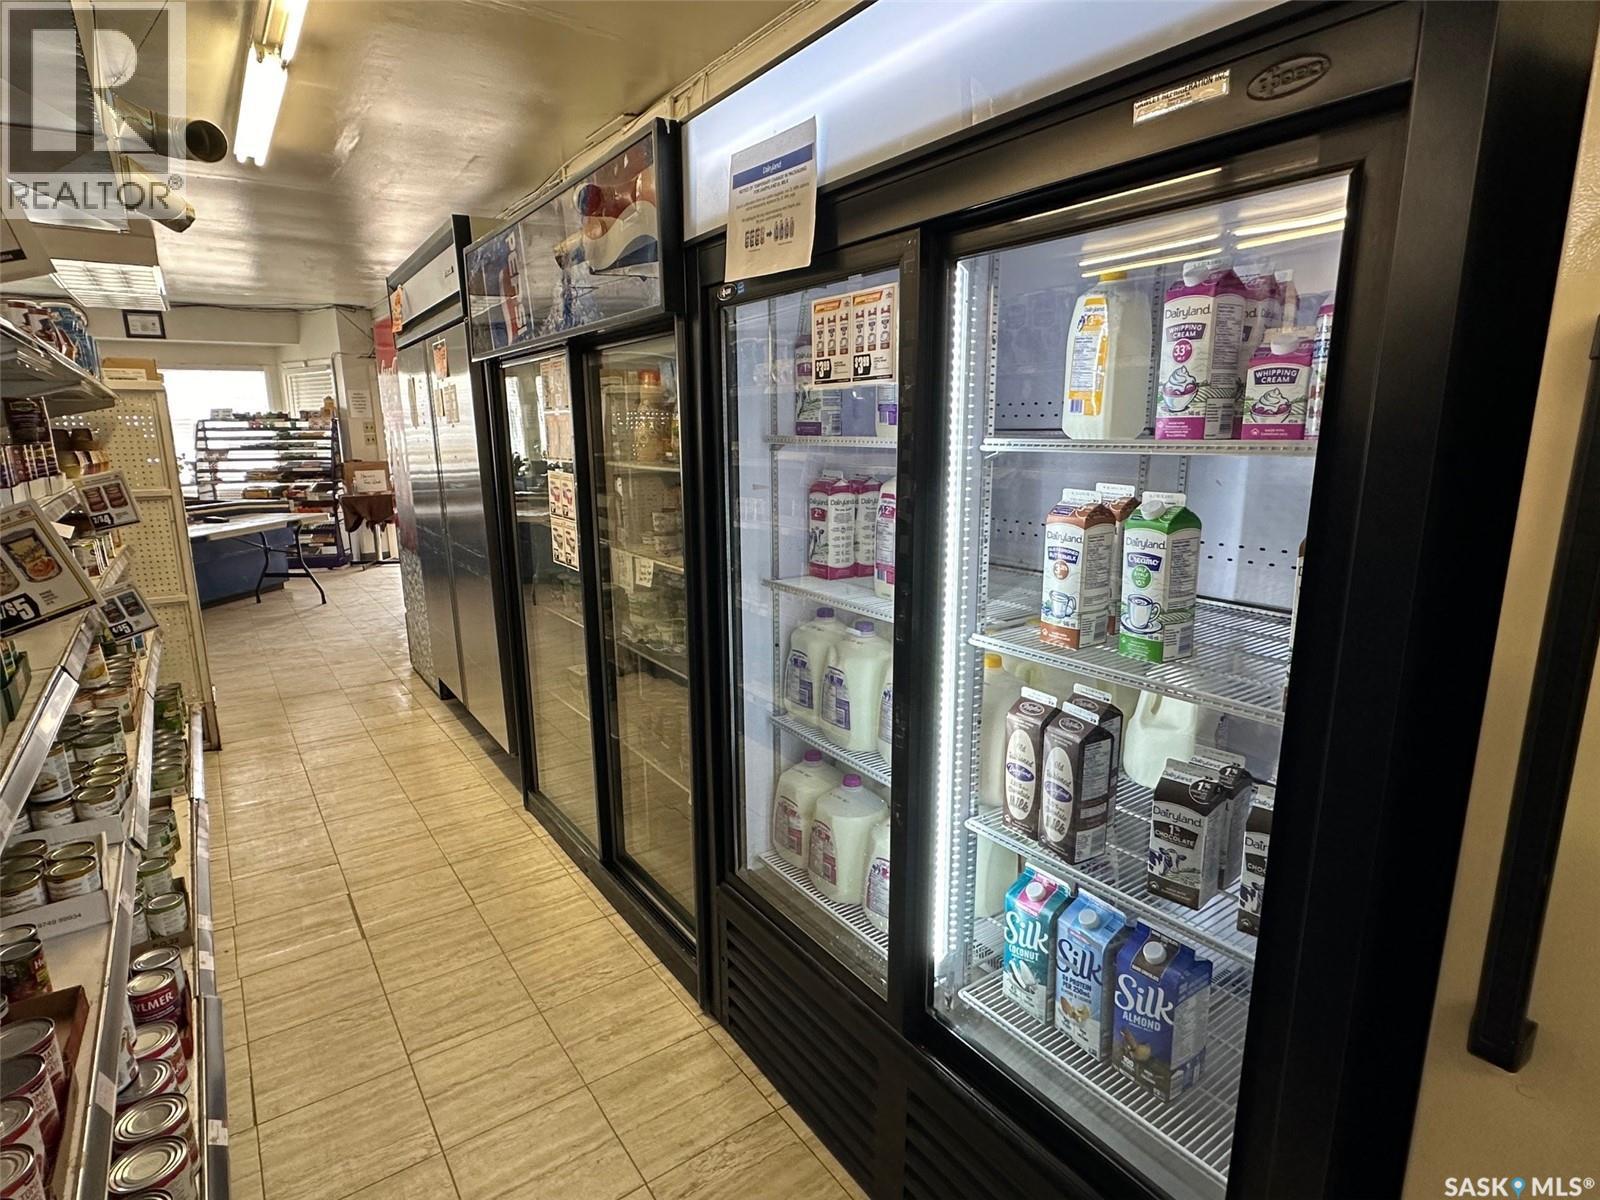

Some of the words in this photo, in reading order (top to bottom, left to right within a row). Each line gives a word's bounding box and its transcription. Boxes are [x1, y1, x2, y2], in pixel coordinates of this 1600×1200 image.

[505, 231, 527, 335] PEPSI
[1165, 303, 1211, 320] Dairyland
[1168, 324, 1202, 334] WHIPPING
[1173, 331, 1197, 339] CREAM
[1255, 369, 1298, 378] WHIPPING
[1261, 376, 1290, 384] CREAM
[1047, 531, 1083, 544] Dairyland
[1126, 536, 1167, 550] Dairyland
[0, 597, 36, 621] /$5
[1153, 805, 1202, 828] Dairyland
[1155, 829, 1195, 847] CHOCOLATE
[1004, 911, 1049, 954] Silk
[1009, 944, 1039, 962] COCONUT
[1056, 938, 1103, 986] Silk
[1062, 981, 1072, 992] PER
[1069, 975, 1092, 992] PROTEIN
[1114, 973, 1174, 1025] Silk
[1122, 1010, 1161, 1032] ALMOND
